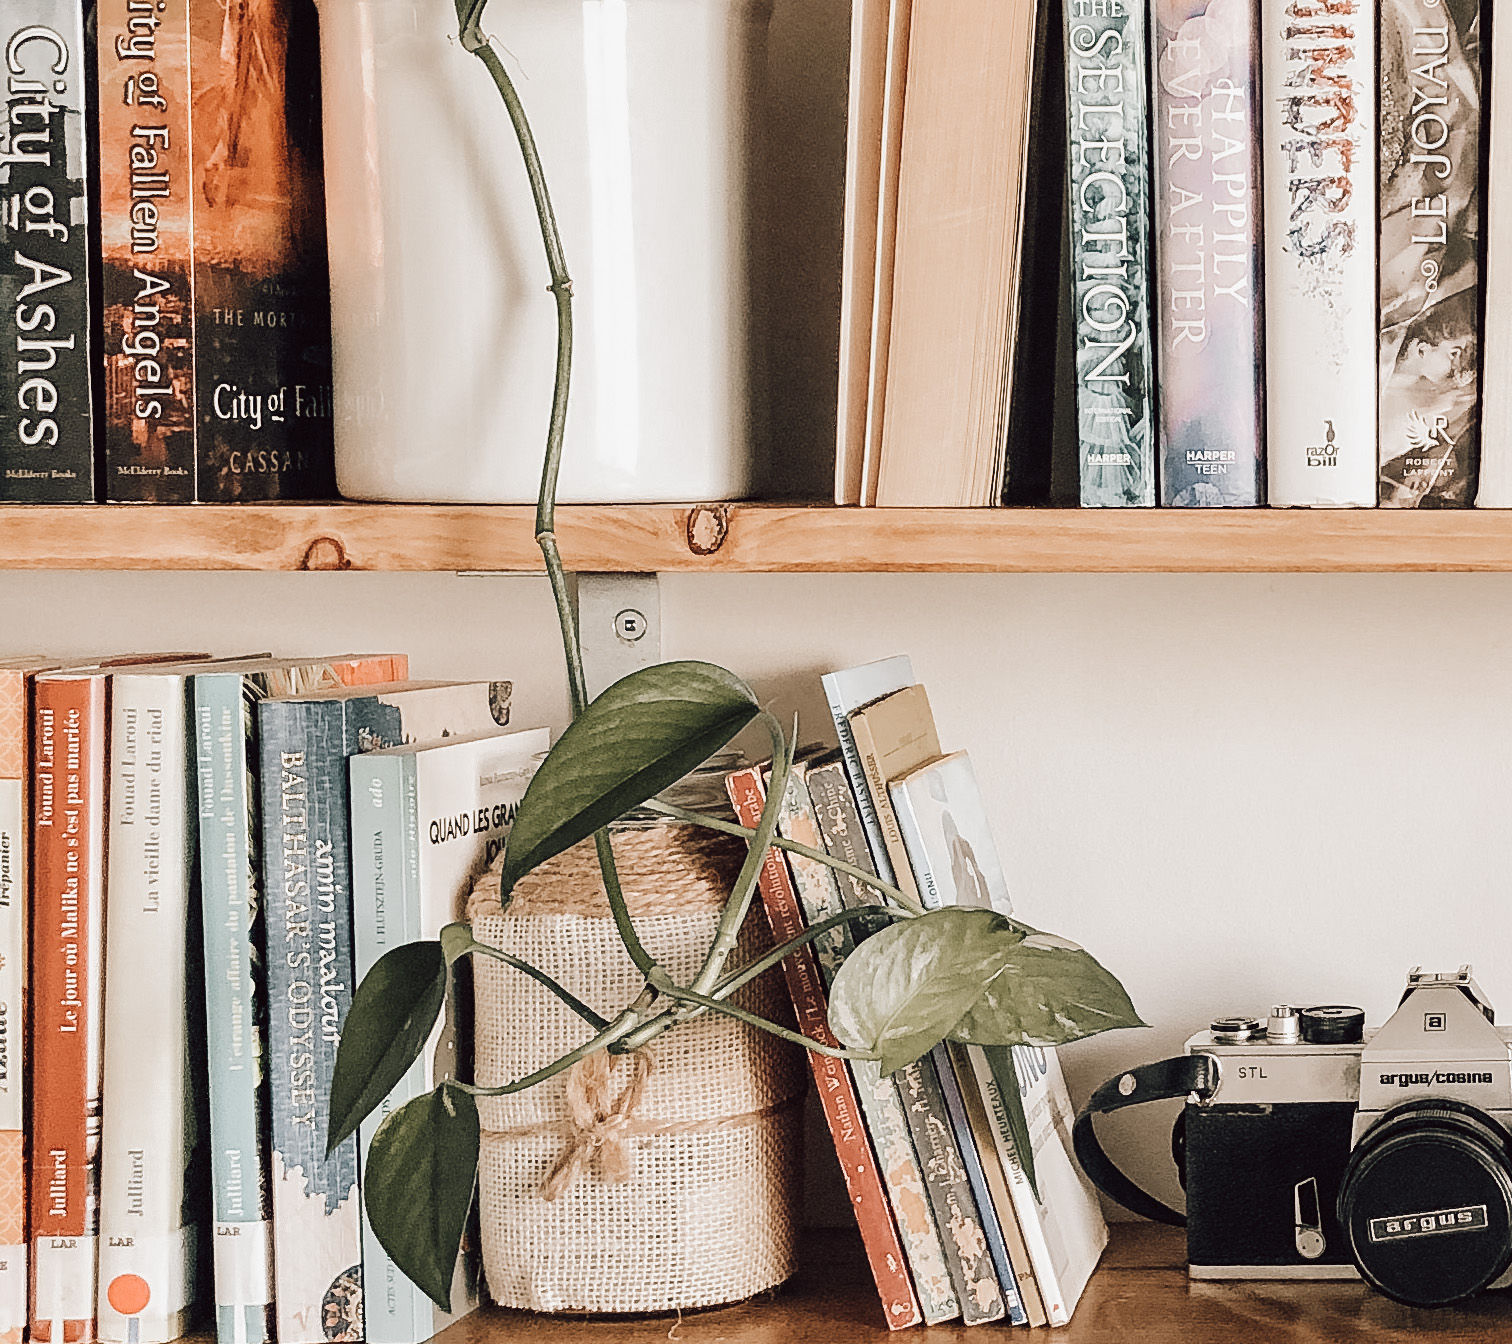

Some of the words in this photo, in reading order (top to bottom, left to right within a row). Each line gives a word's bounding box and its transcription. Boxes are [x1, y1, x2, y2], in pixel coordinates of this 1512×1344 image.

[1074, 0, 1123, 18] THE
[0, 25, 69, 167] City
[125, 70, 168, 111] of
[1167, 39, 1204, 169] EVER
[1410, 26, 1452, 179] JOYAU
[3, 185, 69, 243] of
[130, 123, 171, 255] Fallen
[1070, 25, 1137, 386] SELECTION
[1211, 78, 1248, 308] HAPPILY
[1411, 194, 1447, 245] LE
[1169, 182, 1207, 350] AFTER
[14, 251, 74, 447] Ashes
[122, 269, 173, 420] Angels
[289, 980, 316, 1131] ODYSSEY
[1238, 1067, 1268, 1079] STL
[49, 1149, 68, 1217] Julliard
[1386, 1207, 1473, 1235] argus
